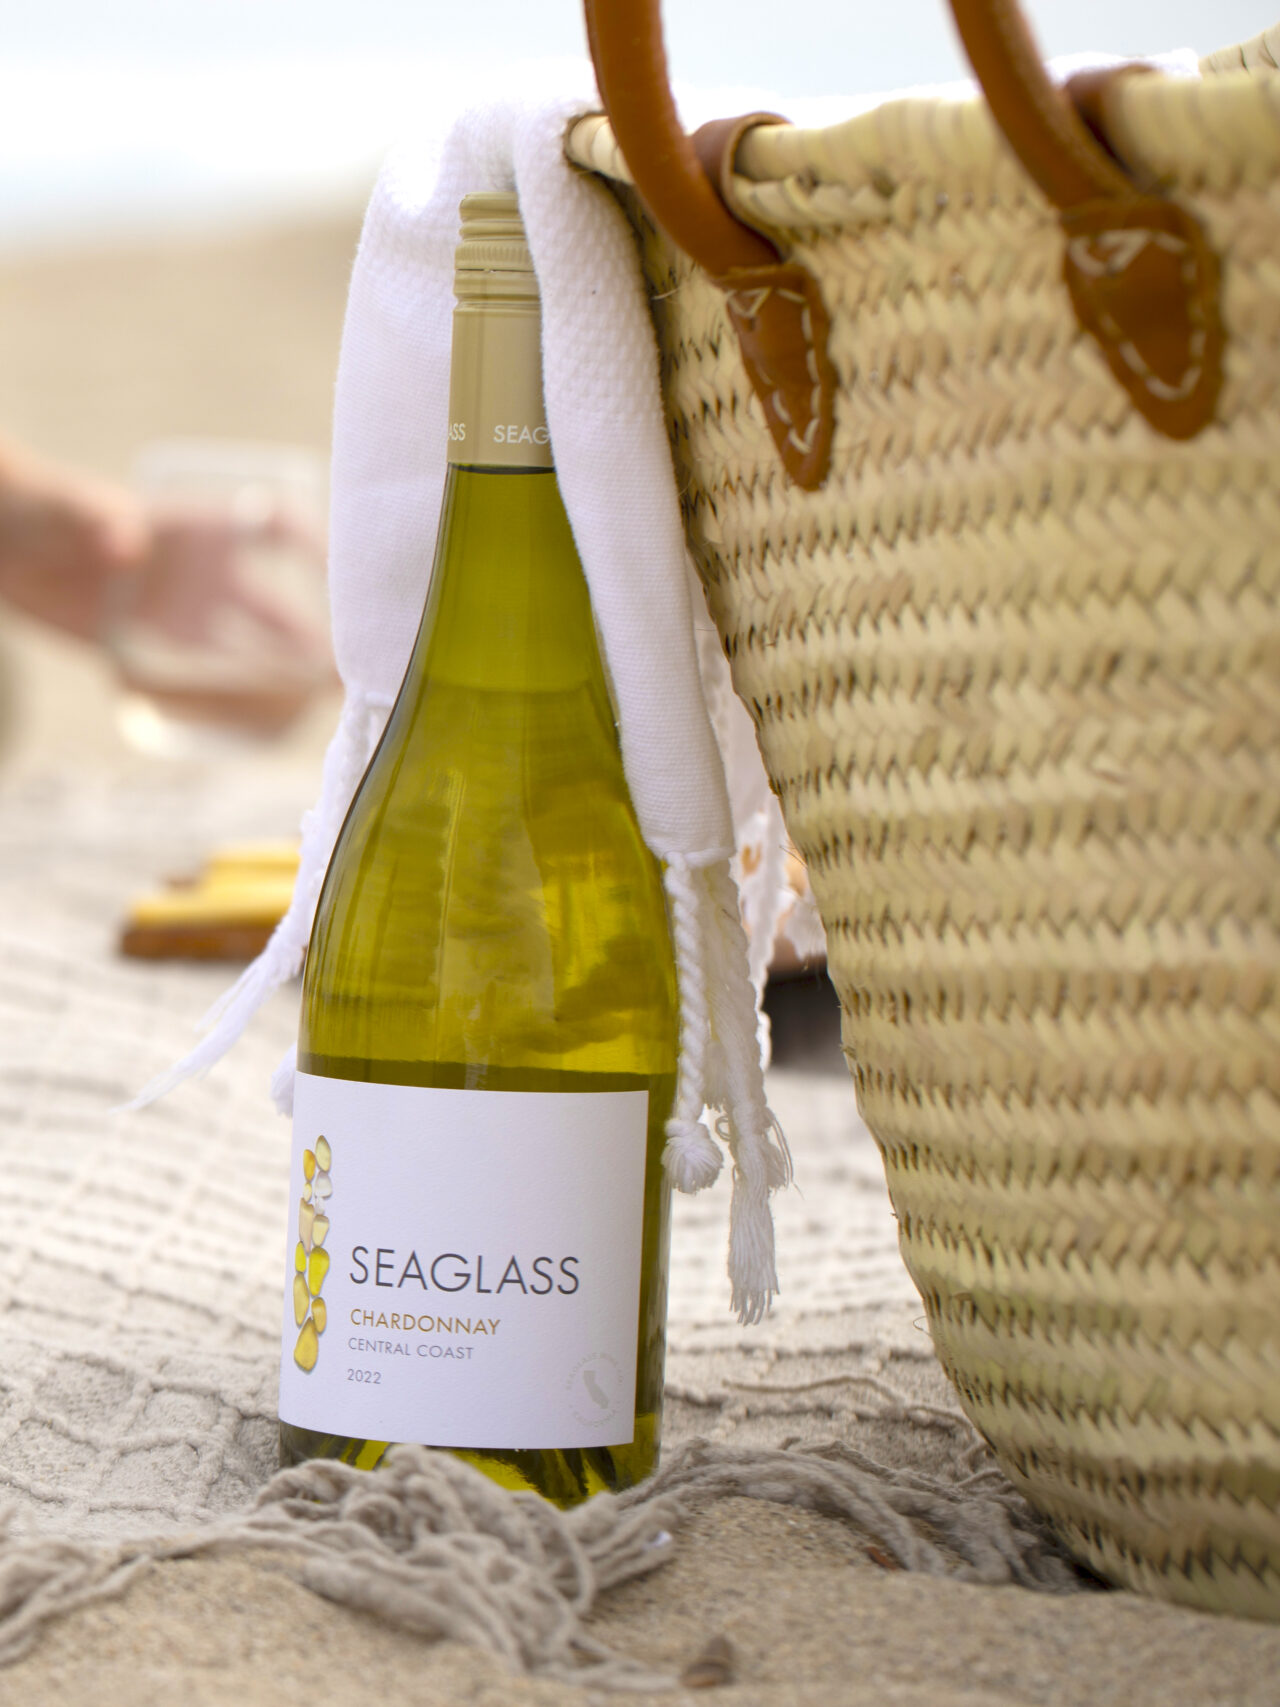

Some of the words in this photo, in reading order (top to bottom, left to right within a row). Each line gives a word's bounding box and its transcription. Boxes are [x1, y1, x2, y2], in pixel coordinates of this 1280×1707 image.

[349, 1245, 581, 1295] SEAGLASS
[349, 1308, 501, 1336] CHARDONNAY
[347, 1337, 412, 1357] CENTRAL
[416, 1344, 475, 1360] COAST
[347, 1368, 382, 1385] 2022
